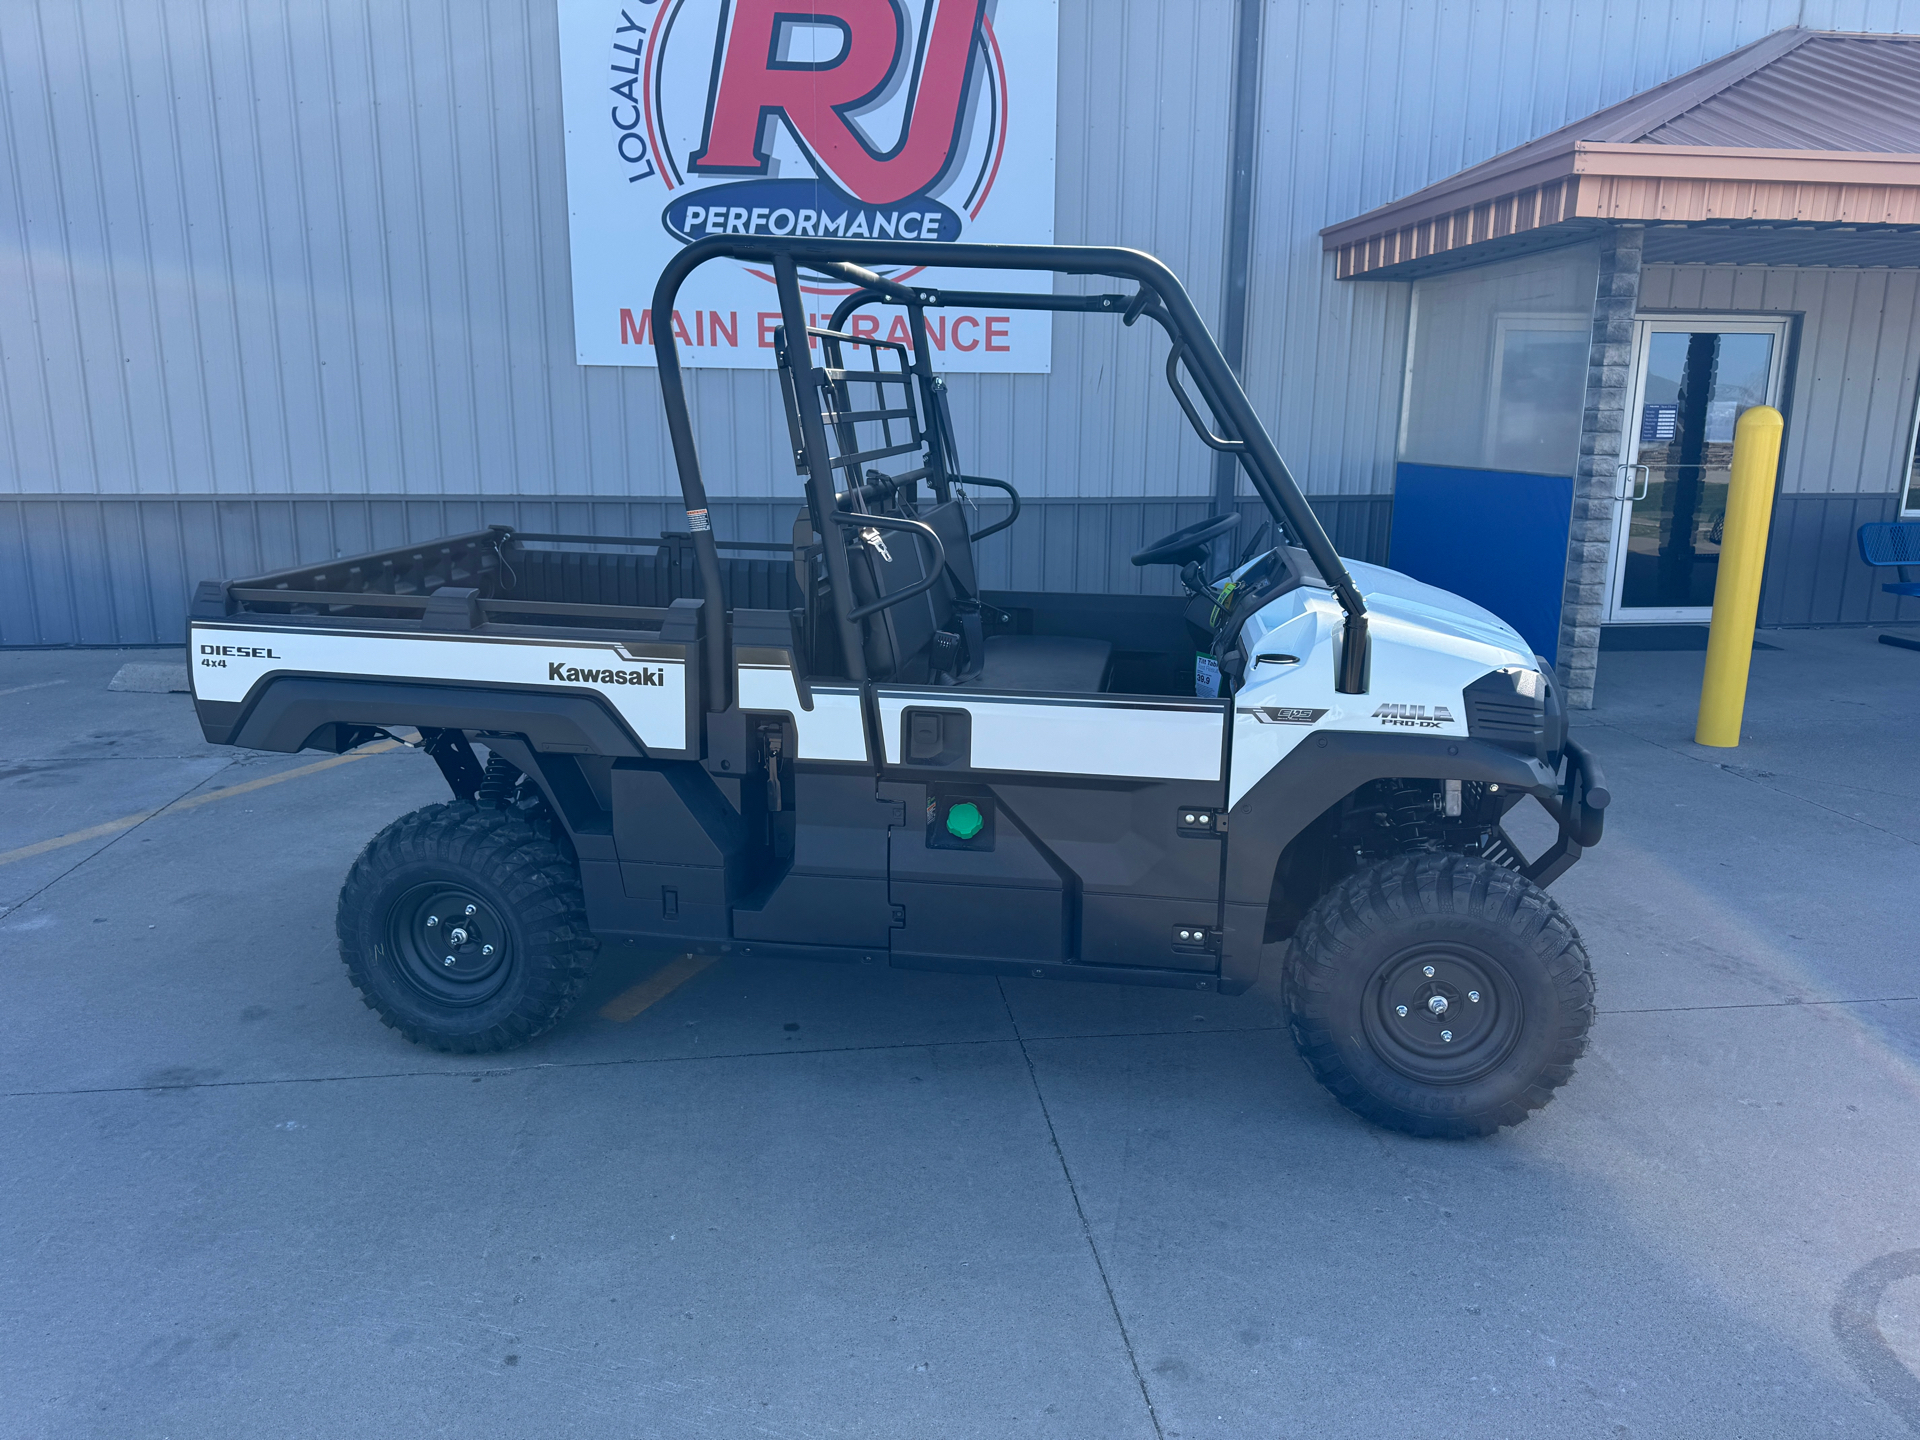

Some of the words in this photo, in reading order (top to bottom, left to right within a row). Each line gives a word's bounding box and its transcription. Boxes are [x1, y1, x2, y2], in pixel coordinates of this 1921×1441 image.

[610, 8, 655, 183] LOCALLY
[683, 205, 942, 239] PERFORMANCE
[757, 311, 1010, 352] ERANCE
[200, 644, 281, 659] DIESEL
[201, 658, 227, 668] 4x4
[548, 662, 664, 687] Kawasaki
[1197, 673, 1210, 685] 39.9
[1371, 702, 1455, 722] MULE
[1381, 719, 1443, 729] PRO-DX
